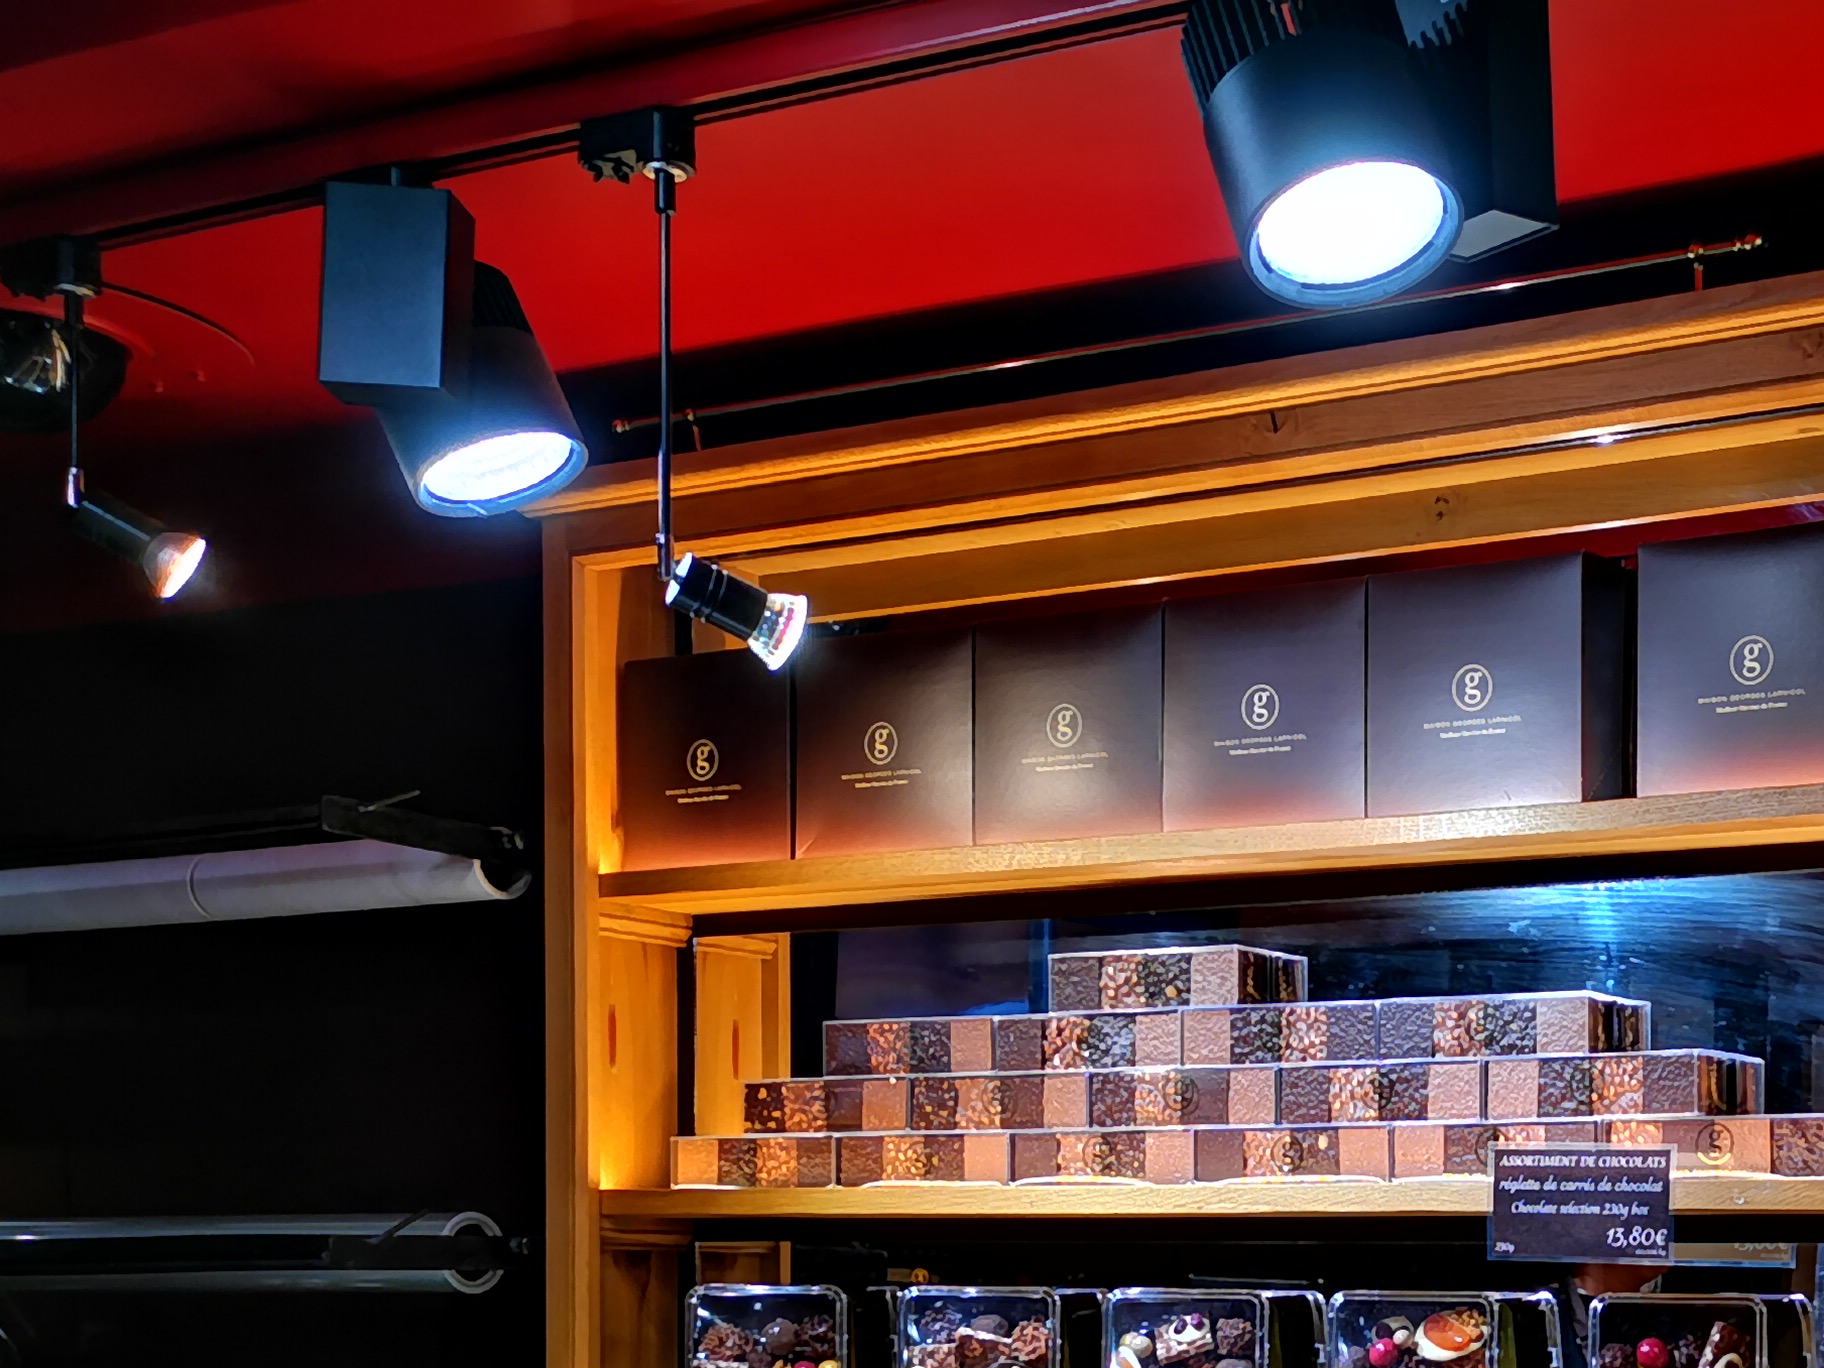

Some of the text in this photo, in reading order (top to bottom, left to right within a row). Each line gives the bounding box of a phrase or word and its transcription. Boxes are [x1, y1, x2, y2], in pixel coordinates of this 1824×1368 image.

[1499, 1155, 1667, 1169] ASSORTIMENT DE CHOCOLATS
[1543, 1175, 1558, 1191] de
[1597, 1175, 1613, 1192] de
[1614, 1176, 1663, 1193] chocolat
[1606, 1226, 1668, 1248] 13,80€
